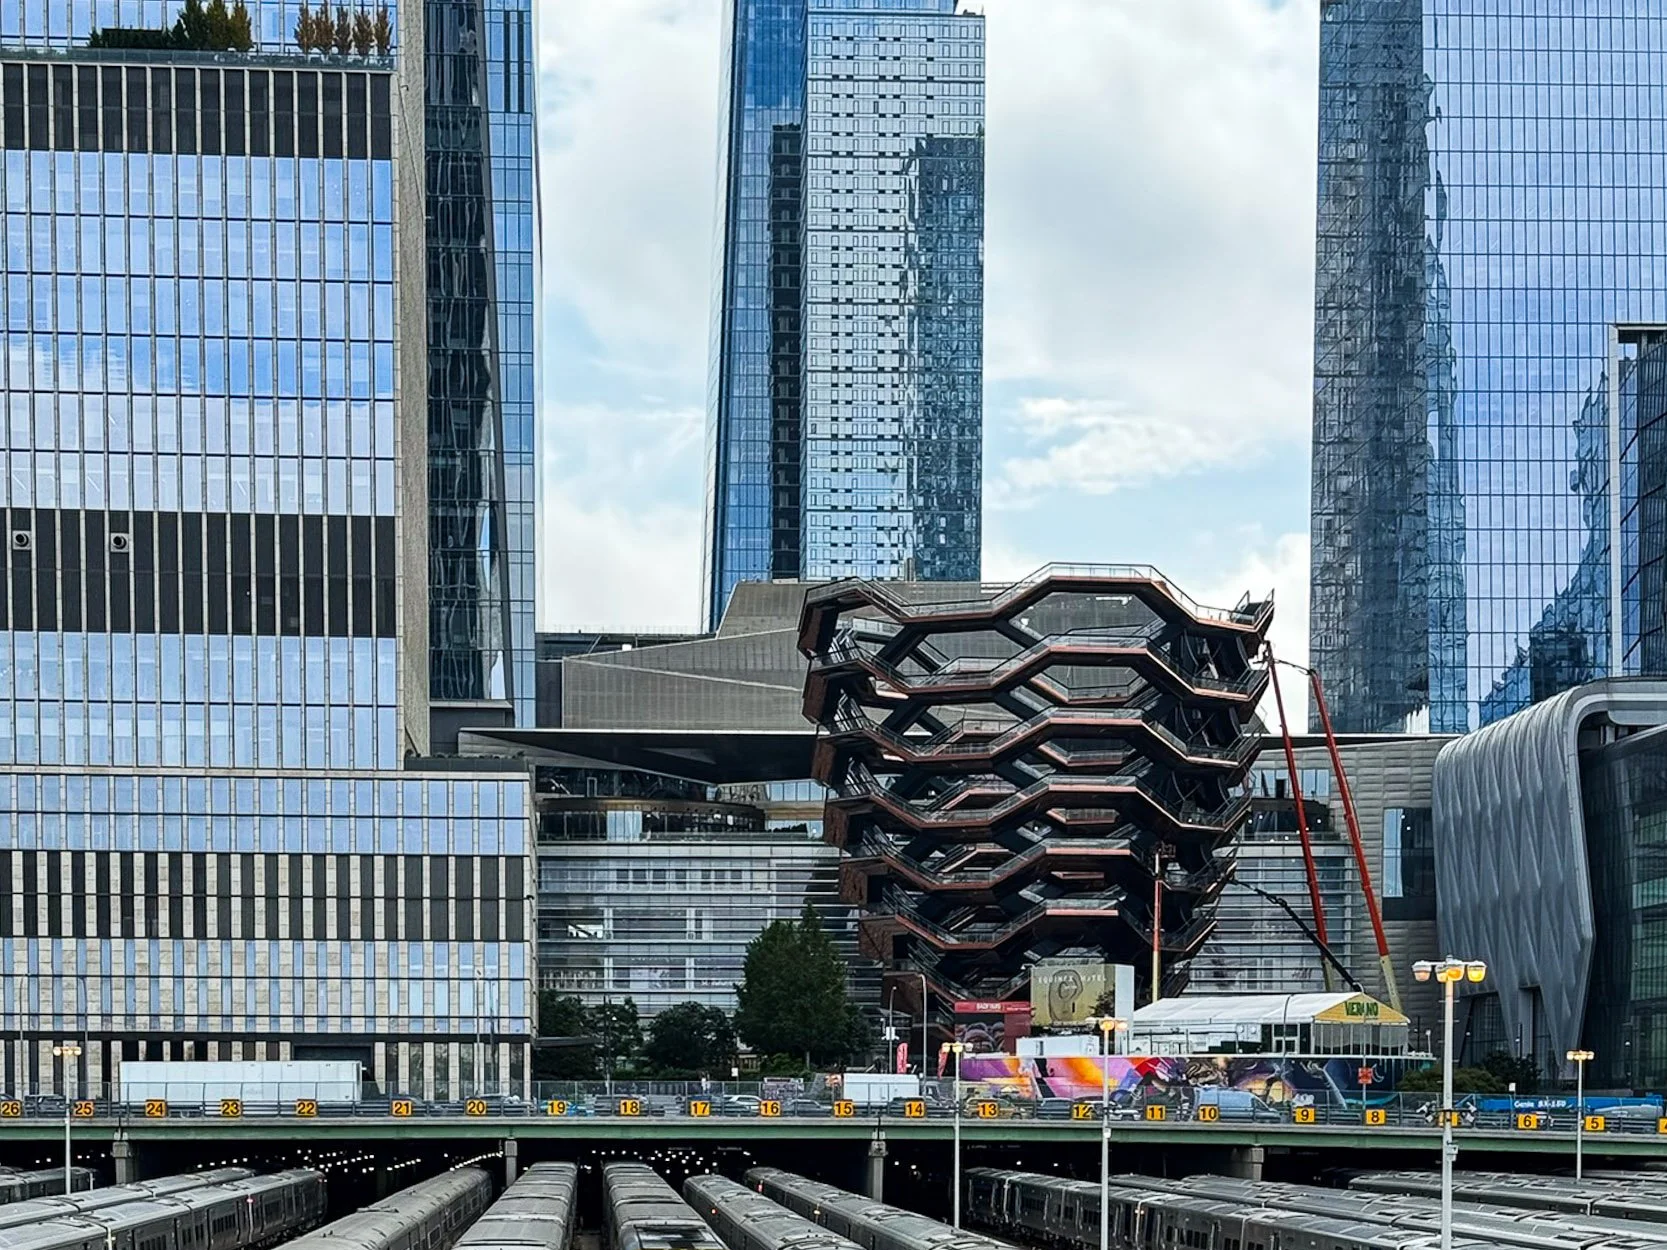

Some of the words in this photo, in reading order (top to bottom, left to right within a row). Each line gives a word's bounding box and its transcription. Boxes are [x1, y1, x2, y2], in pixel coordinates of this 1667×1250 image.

[1, 1102, 20, 1115] 26
[75, 1102, 93, 1115] 25
[146, 1102, 163, 1115] 24
[222, 1102, 239, 1115] 23
[298, 1102, 315, 1115] 22
[395, 1102, 409, 1115] 21
[468, 1101, 485, 1114] 20
[549, 1101, 565, 1114] 19
[621, 1101, 639, 1114] 18
[693, 1102, 709, 1114] 17
[763, 1102, 779, 1114] 16
[835, 1102, 852, 1114] 15
[908, 1103, 922, 1115] 14
[982, 1103, 997, 1115] 13
[1075, 1105, 1092, 1118] 12
[1149, 1107, 1163, 1118] 11
[1201, 1107, 1215, 1119] 10
[1301, 1109, 1309, 1121] 9
[1372, 1111, 1380, 1122] 8
[1524, 1115, 1532, 1127] 6
[1591, 1118, 1599, 1130] 5
